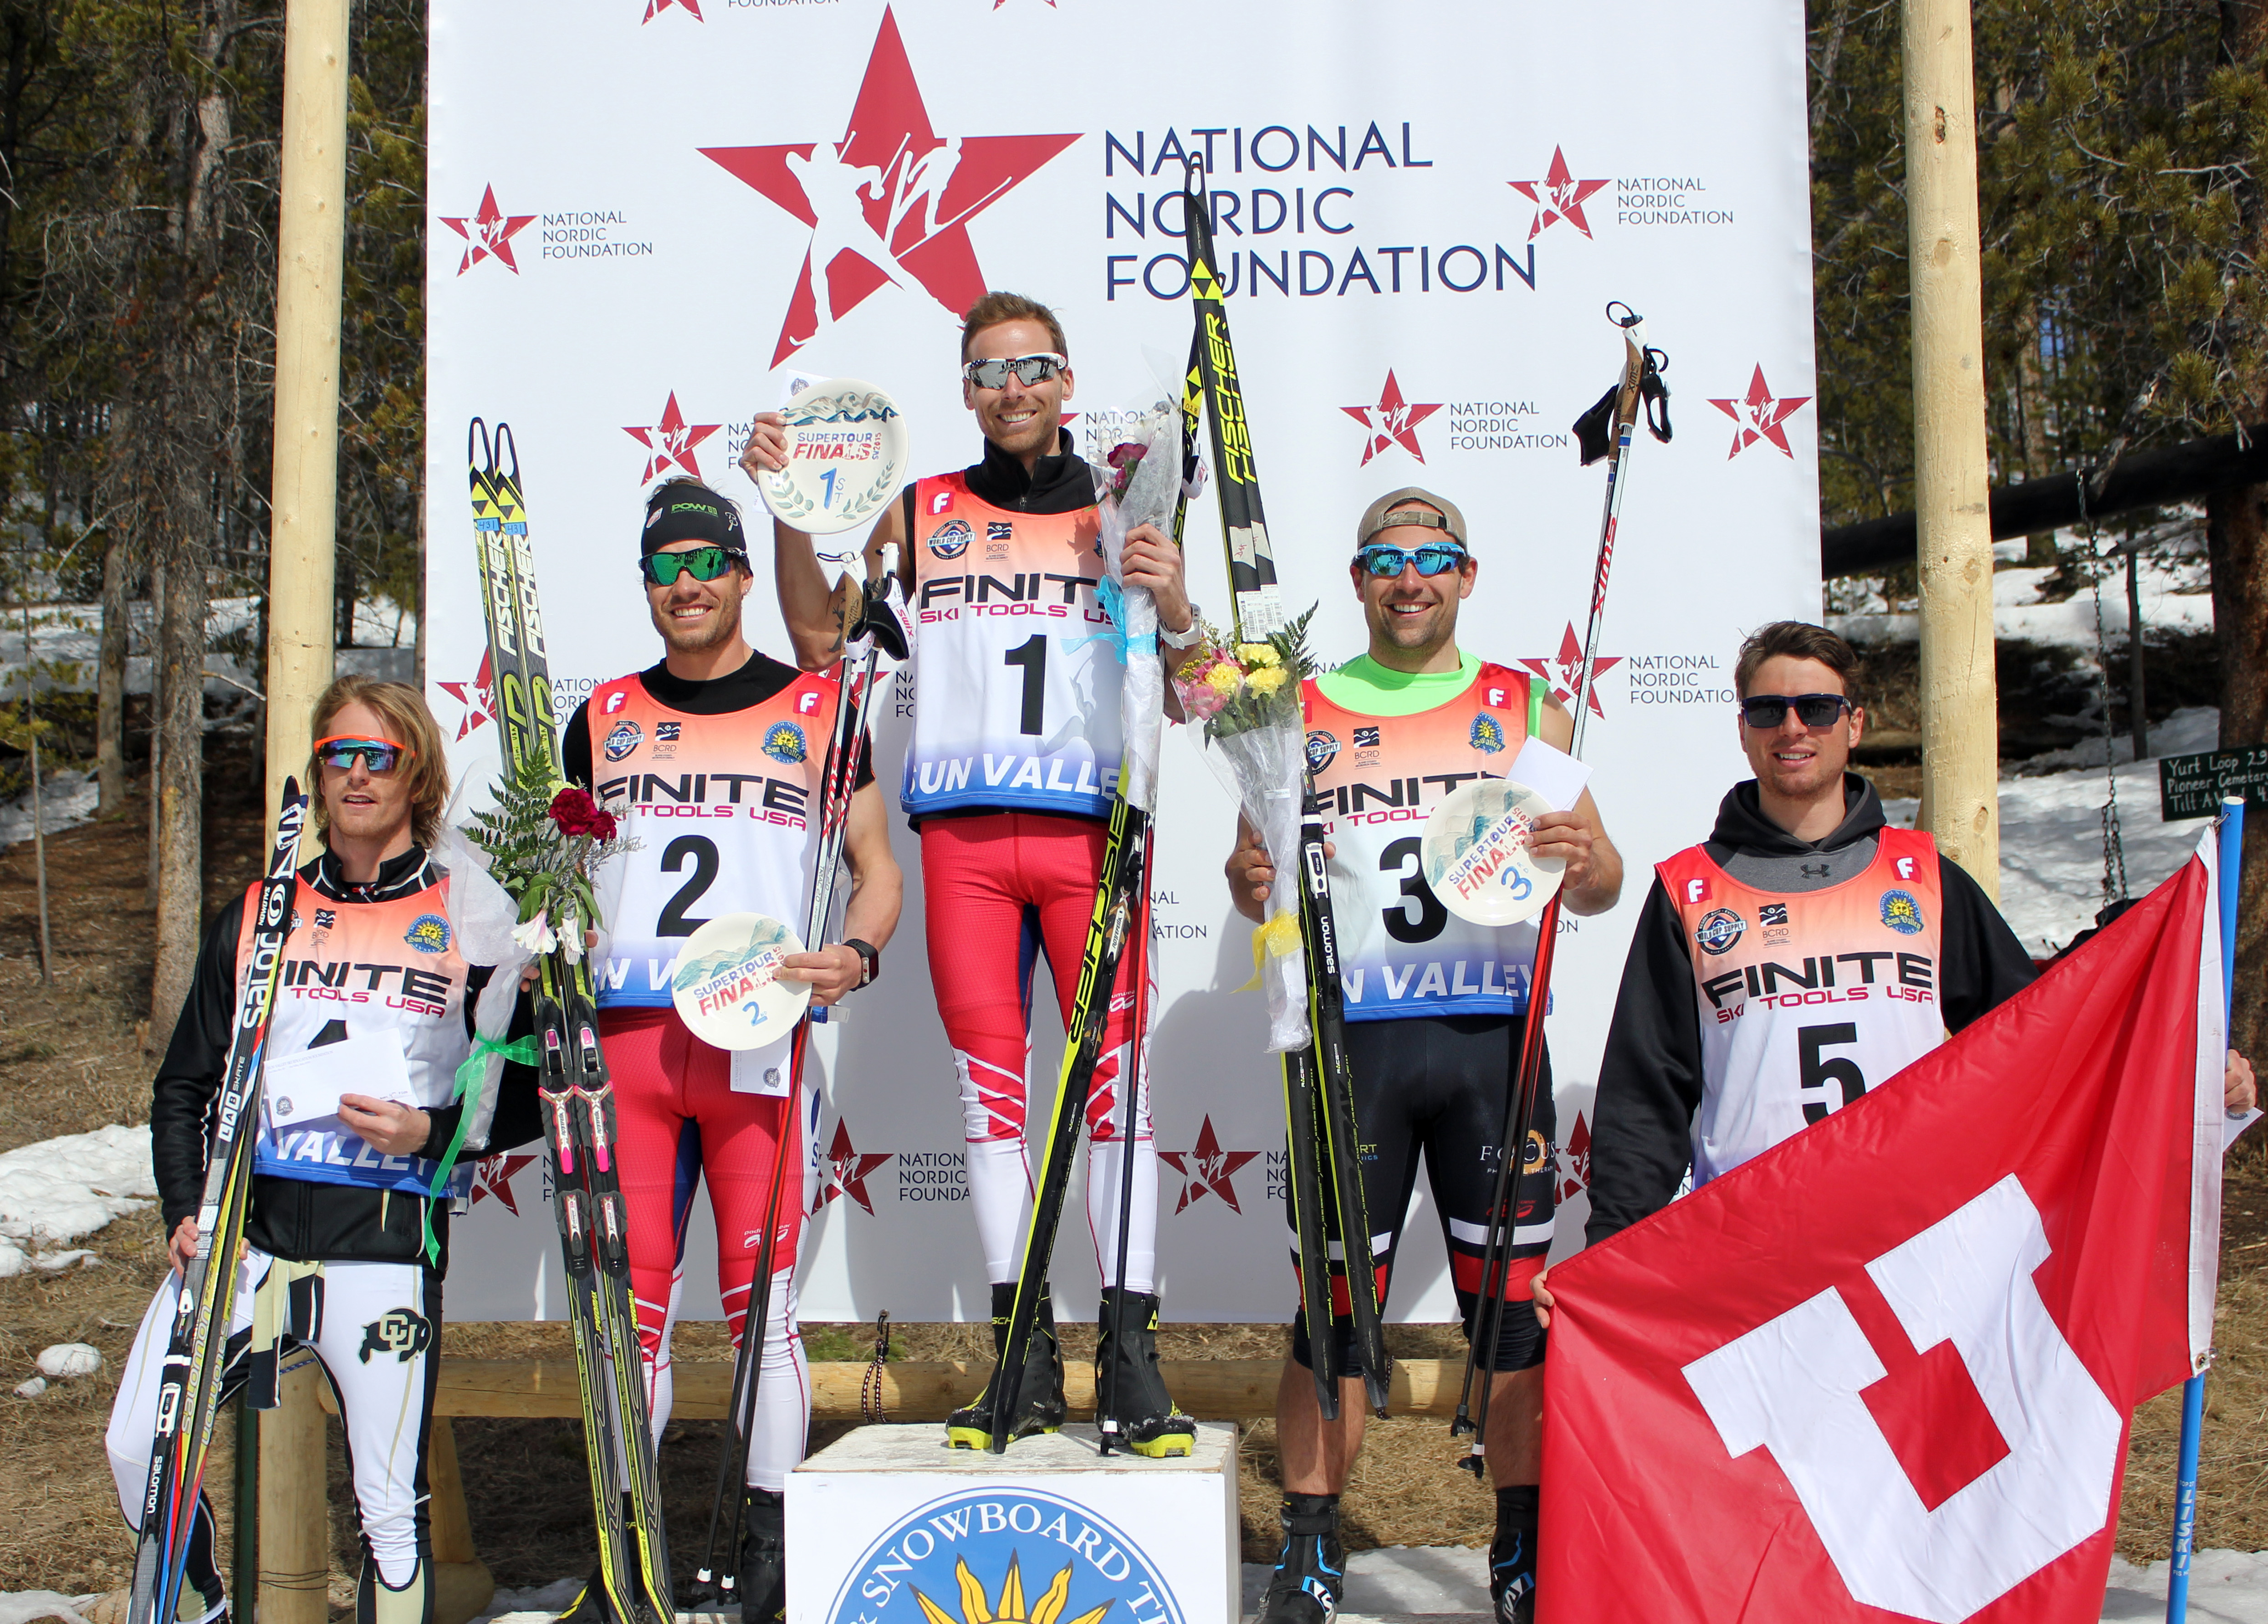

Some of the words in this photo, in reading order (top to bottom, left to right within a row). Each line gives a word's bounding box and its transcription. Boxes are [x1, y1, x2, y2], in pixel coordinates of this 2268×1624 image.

[1105, 119, 1433, 177] NATIONAL
[1617, 177, 1706, 191] NATIONAL
[1105, 186, 1354, 239] NORDIC
[1618, 194, 1685, 208] NORDIC
[543, 210, 627, 227] NATIONAL
[1618, 211, 1733, 225] FOUNDATION
[543, 228, 606, 243] NORDIC
[543, 242, 653, 260] FOUNDATION
[1106, 242, 1535, 301] FOUNDATION
[1205, 312, 1244, 485] FISCHER
[1451, 401, 1540, 416] NATIONAL
[797, 432, 873, 443] SUPERTOUR
[1451, 419, 1518, 433] NORDIC
[792, 444, 872, 460] FINALS
[1451, 434, 1568, 449] FOUNDATION
[479, 520, 496, 530] 431
[507, 524, 524, 534] 431
[986, 544, 1009, 552] BCRD
[486, 531, 517, 656] FISCHER
[513, 535, 545, 659] FISCHER
[920, 573, 1107, 609] FINIT
[920, 608, 959, 623] SKI
[970, 603, 1068, 617] TOOLS
[1629, 655, 1719, 669] NATIONAL
[1005, 634, 1047, 735] 1
[1630, 672, 1699, 687] NORDIC
[1630, 689, 1739, 704] FOUNDATIO
[1354, 750, 1379, 760] BCRD
[2168, 756, 2201, 777] Yurt
[2209, 756, 2238, 773] Loop
[983, 753, 1119, 801] VALLE
[2166, 777, 2214, 794] Pioneer
[597, 773, 809, 817] FINITE
[1316, 771, 1506, 816] FINIT
[635, 804, 733, 817] TOOLS
[749, 807, 806, 832] USA
[1448, 815, 1517, 885] SUPERTOUR
[1456, 823, 1528, 901] FINALS
[656, 834, 720, 937] 2
[1379, 837, 1448, 943] 3
[258, 886, 270, 926] SALOMON
[1070, 791, 1126, 1043] FISCHER
[1724, 922, 1744, 933] SUPPLY
[1762, 928, 1789, 939] BCRD
[284, 960, 452, 1006] INITE
[693, 951, 775, 999] SUPERTOUR
[1701, 951, 1932, 1009] FINITE
[290, 987, 370, 1003] TOOLS
[386, 995, 446, 1018] USA
[1716, 1003, 1744, 1024] SKI
[1759, 986, 1869, 1011] TOOLS
[1886, 985, 1933, 1005] USA
[232, 1055, 245, 1091] SKATE
[1798, 1022, 1866, 1127] 5
[899, 1152, 965, 1167] NATION
[899, 1170, 966, 1184] NORDIC
[899, 1186, 970, 1201] FOUNDA
[862, 1502, 1131, 1608] SNOWBOARD
